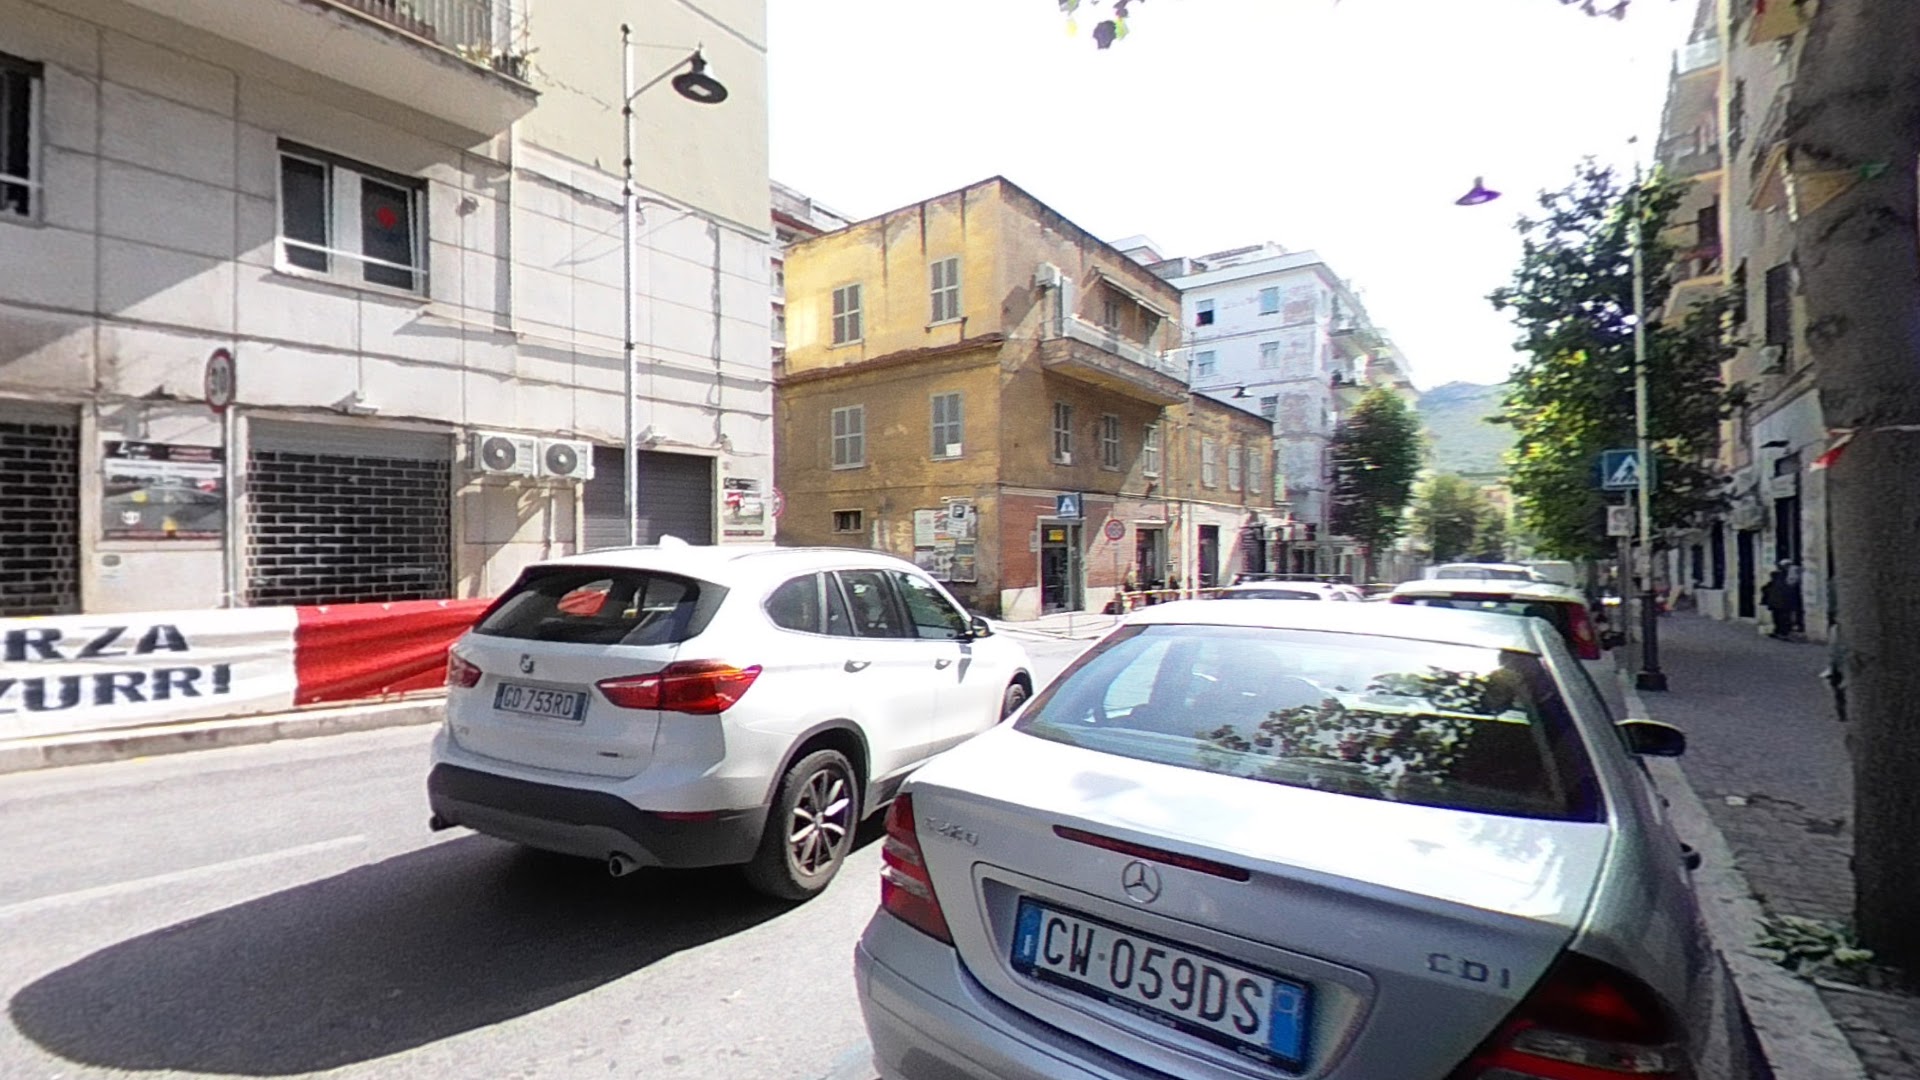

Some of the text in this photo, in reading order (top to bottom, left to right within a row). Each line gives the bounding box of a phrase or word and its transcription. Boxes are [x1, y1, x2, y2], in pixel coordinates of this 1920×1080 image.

[4, 625, 188, 661] RZA
[1043, 918, 1094, 976] CW
[1110, 938, 1263, 1035] 059DS
[1426, 952, 1510, 989] CDI
